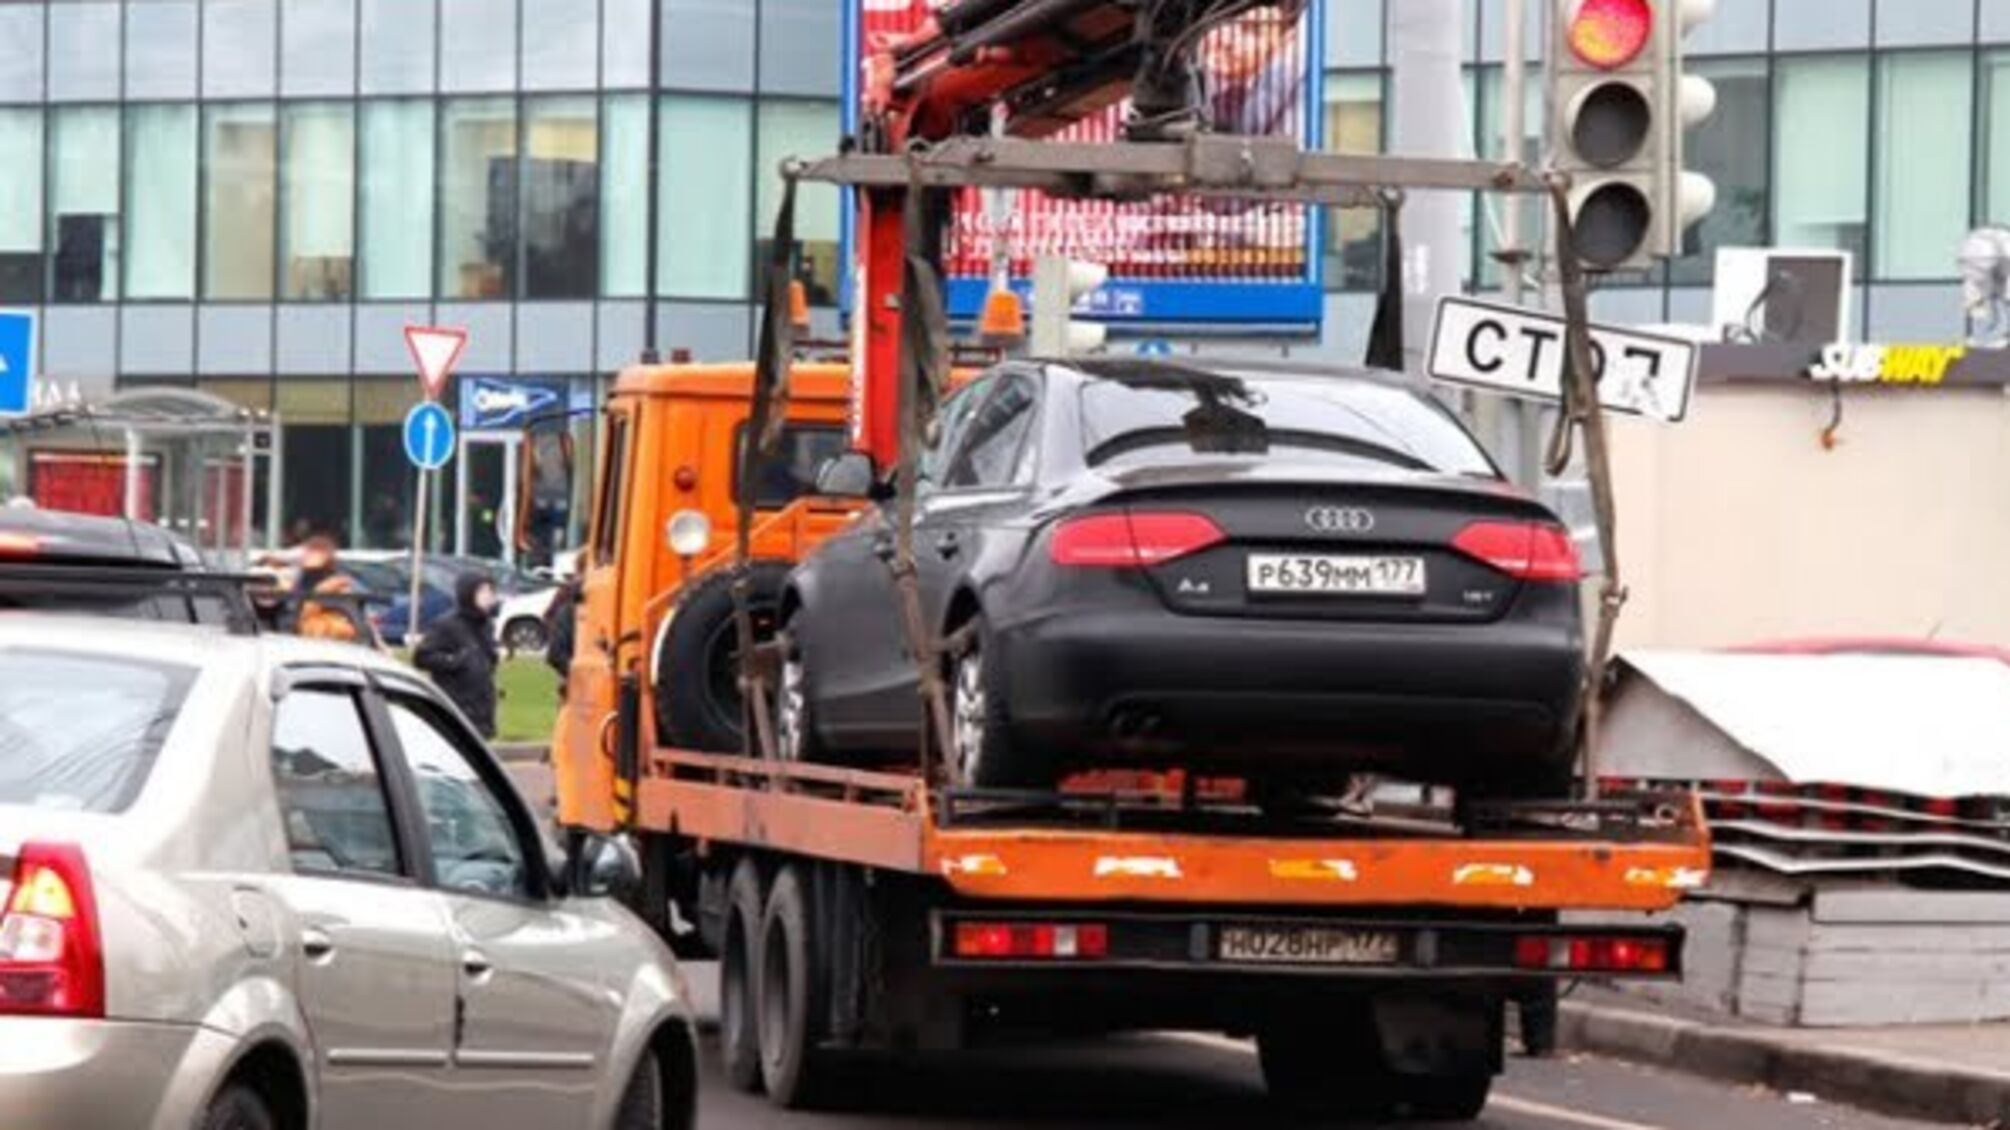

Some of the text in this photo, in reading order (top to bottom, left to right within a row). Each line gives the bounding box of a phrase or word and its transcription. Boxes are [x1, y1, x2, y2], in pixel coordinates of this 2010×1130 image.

[1808, 343, 1965, 383] SUBWAY
[1257, 558, 1371, 589] Р639ММ
[1376, 559, 1417, 582] 177
